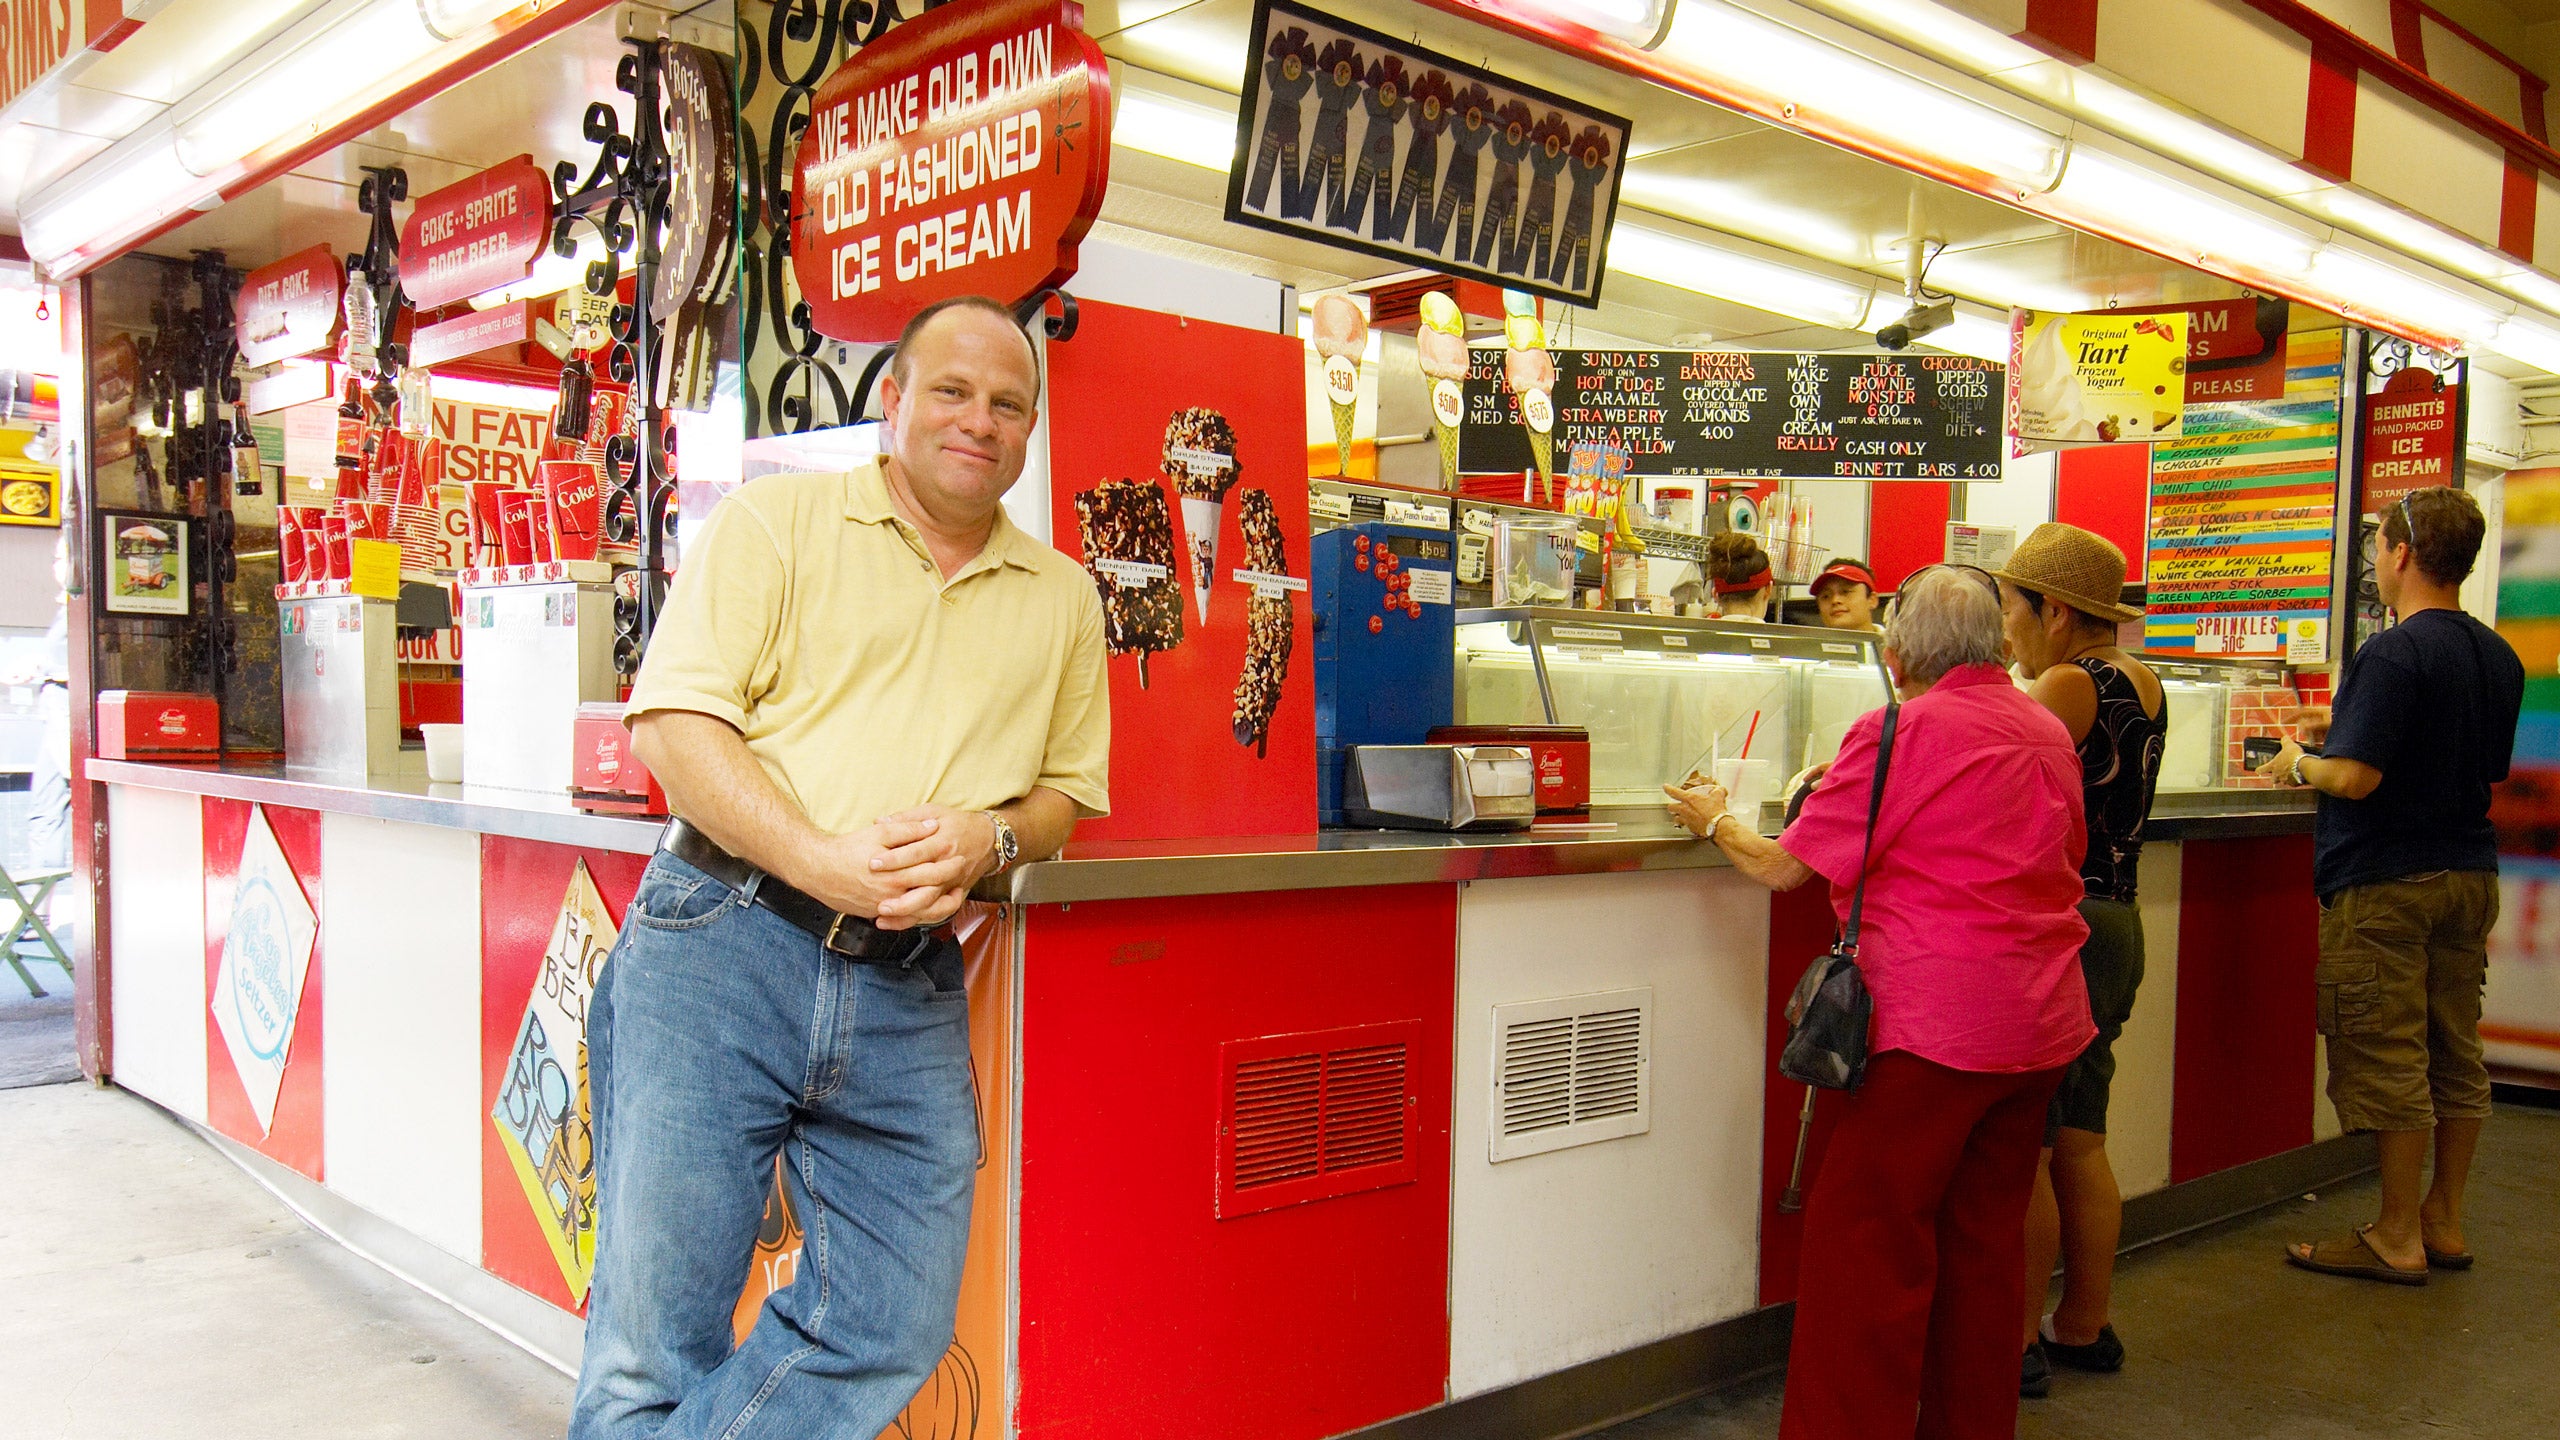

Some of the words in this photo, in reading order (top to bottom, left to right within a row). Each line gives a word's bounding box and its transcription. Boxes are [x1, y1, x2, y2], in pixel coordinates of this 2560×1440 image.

[667, 49, 710, 122] FROZEN
[817, 102, 849, 163] WE
[857, 74, 919, 151] MAKE
[928, 52, 978, 123] OUR
[988, 23, 1052, 100] OWN
[822, 170, 869, 235] OLD
[880, 109, 1042, 216] FASHIONED
[832, 235, 881, 301] ICE
[895, 190, 1031, 282] CREAM
[427, 246, 465, 284] ROOT
[469, 231, 509, 267] BEER
[257, 280, 280, 312] DIET
[282, 268, 310, 301] COKE
[2082, 328, 2128, 341] Original
[1581, 352, 1660, 368] SUNDAES
[1692, 353, 1750, 367] FROZEN
[1795, 354, 1818, 368] WE
[1875, 356, 1892, 364] THE
[2077, 342, 2130, 365] Tart
[1597, 368, 1613, 376] OUR
[1618, 369, 1635, 377] OWN
[1680, 366, 1755, 381] BANANAS
[1786, 367, 1829, 382] MAKE
[1862, 363, 1907, 378] FUDGE
[1936, 370, 1986, 385] DIPPED
[2076, 365, 2117, 377] Frozen
[1576, 376, 1605, 389] HOT
[1615, 377, 1665, 392] FUDGE
[1704, 380, 1730, 388] DIPPED
[1732, 380, 1741, 388] IN
[1791, 381, 1819, 395] OUR
[1849, 376, 1915, 391] BROWNIE
[2087, 376, 2125, 390] Yogurt
[2192, 378, 2254, 396] PLEASE
[1579, 391, 1660, 406] CARAMEL
[1682, 387, 1767, 402] CHOCOLATE
[1789, 394, 1822, 409] OWN
[1848, 389, 1916, 404] MONSTER
[1688, 401, 1724, 409] COVERED
[1867, 403, 1901, 418] 6.00
[1938, 398, 1985, 411] SCREW
[2373, 398, 2445, 421] BENNETT'S
[1470, 410, 1503, 425] MED
[1561, 408, 1668, 424] STRAWBERRY
[1682, 409, 1751, 423] ALMONDS
[1794, 408, 1818, 422] ICE
[1838, 416, 1858, 425] JUST
[1891, 416, 1911, 425] DARE
[1913, 417, 1923, 425] YA
[1949, 410, 1972, 424] THE
[1567, 425, 1663, 441] PINEAPPLE
[1700, 425, 1734, 440] 4.00
[1783, 421, 1833, 436] CREAM
[1945, 424, 1975, 437] DIET
[2372, 423, 2403, 436] HAND
[2405, 419, 2444, 433] PACKED
[1777, 435, 1839, 451] REALLY
[2171, 435, 2219, 448] BUTTER
[2226, 430, 2276, 443] PECAN
[2391, 437, 2424, 455] ICE
[1845, 440, 1887, 455] CASH
[1889, 441, 1928, 456] ONLY
[2171, 446, 2239, 458] PISTACHIO
[1200, 453, 1232, 465] STICKS
[2162, 457, 2225, 472] CHOCOLATE
[1764, 468, 1783, 476] FAST
[1834, 461, 1904, 476] BENNETT
[1917, 463, 1957, 477] BARS
[1963, 463, 1999, 477] 4.00
[2371, 457, 2442, 478] CREAM
[2162, 481, 2194, 494] MINT
[2202, 479, 2232, 491] CHIP
[2371, 490, 2383, 498] TO
[557, 483, 597, 509] Coke
[2164, 491, 2240, 504] STRAWBERRY
[2163, 504, 2199, 516] COFFEE
[2201, 502, 2227, 513] CHIP
[504, 509, 528, 526] Cok
[2162, 516, 2194, 527] OREO
[2200, 513, 2248, 526] COOKIES
[2271, 508, 2312, 520] CREAM
[2155, 527, 2188, 538] FANCY
[2166, 537, 2208, 548] BUBBLE
[2214, 535, 2241, 546] GUM
[2175, 546, 2231, 559] PUMPKIN
[1097, 560, 1140, 572] BENNETT
[1141, 566, 1166, 575] BARS
[2167, 559, 2217, 571] CHERRY
[2225, 555, 2282, 567] VANILLA
[1235, 571, 1268, 583] FROZEN
[1268, 577, 1306, 588] BANANAS
[2156, 571, 2189, 581] WHITE
[2193, 568, 2248, 579] CHOCOLATE
[2255, 564, 2316, 577] RASPBERRY
[2157, 581, 2220, 592] PEPPERMINT
[2228, 580, 2263, 590] STICK
[2156, 593, 2192, 603] GREEN
[2200, 590, 2238, 601] APPLE
[2249, 588, 2296, 600] SORBET
[2155, 603, 2207, 614] CABERNET
[2214, 601, 2271, 613] SAUVIGNON
[2277, 599, 2322, 610] SORBET
[2196, 616, 2278, 636] SPRINKLES
[2221, 635, 2245, 652] 50¢
